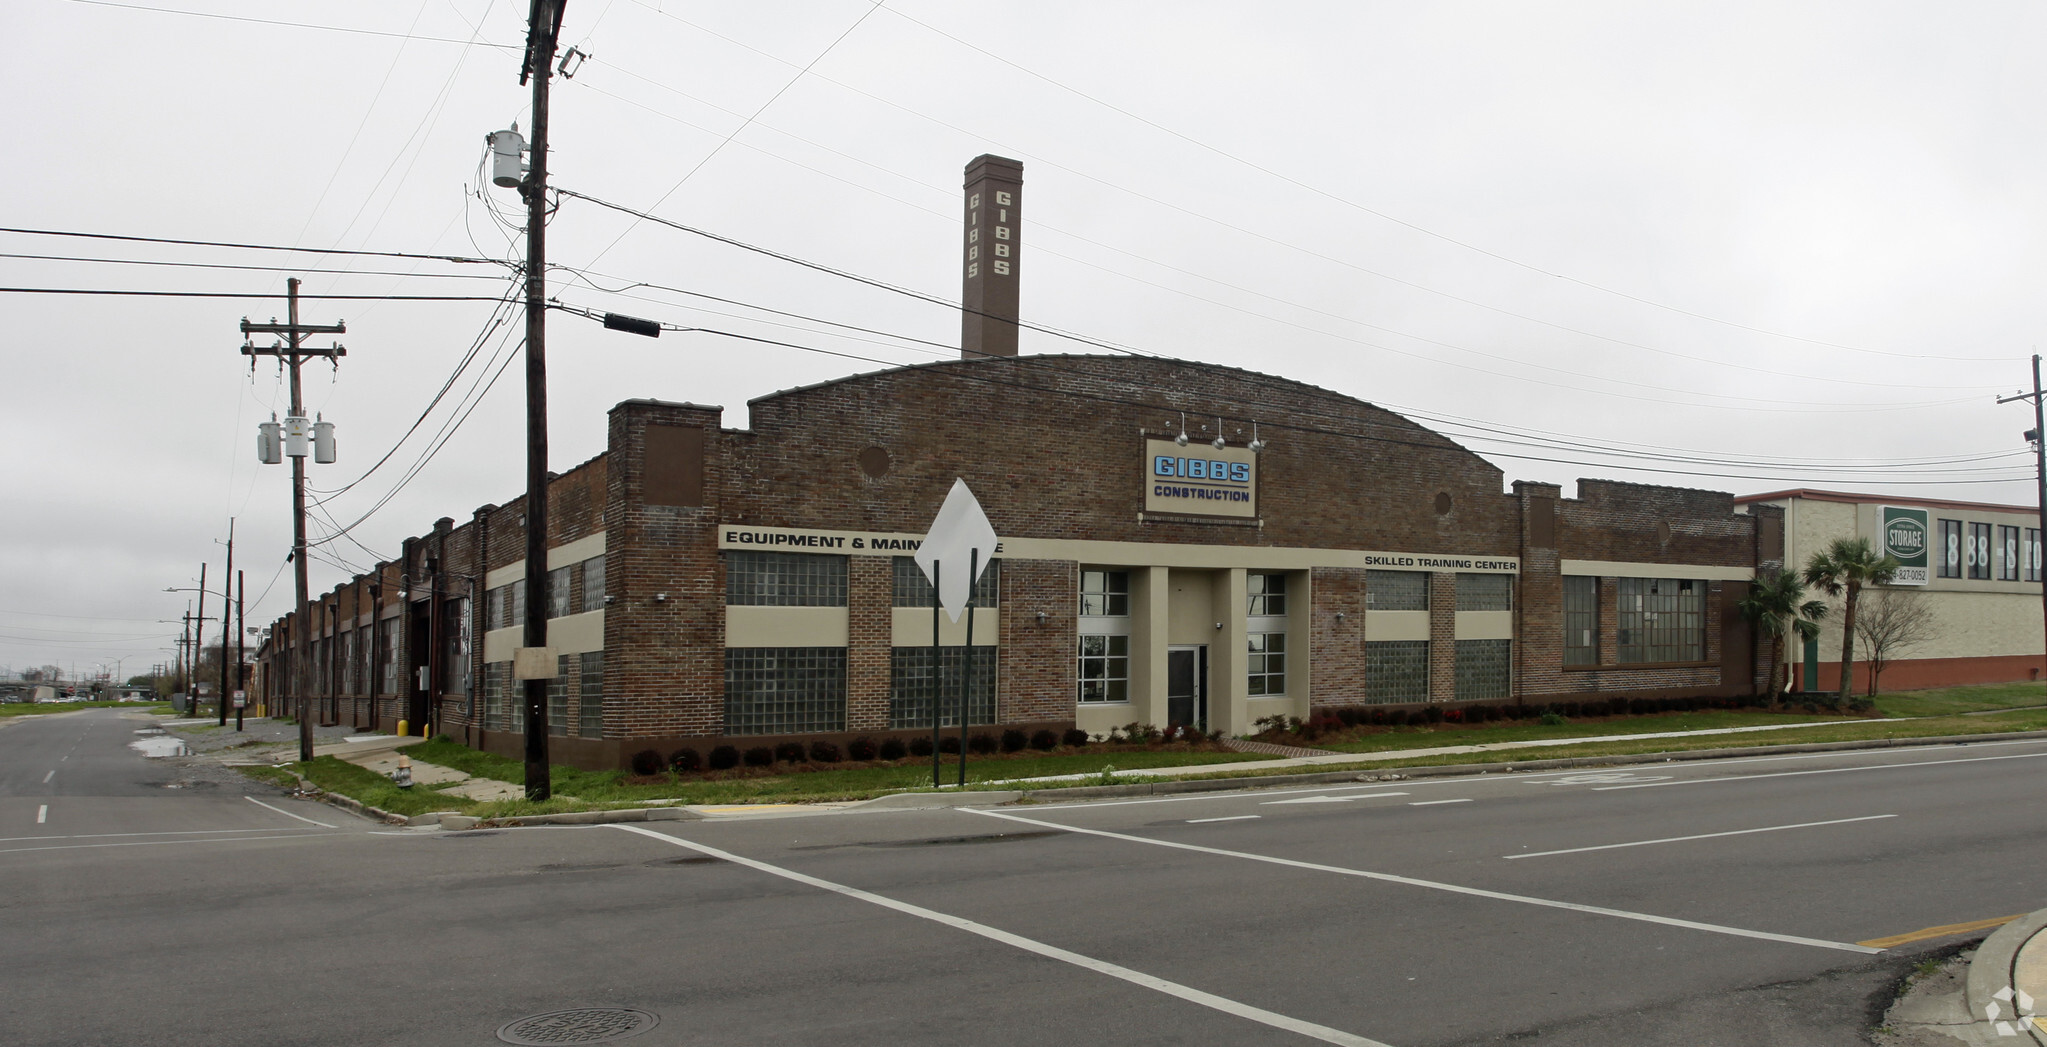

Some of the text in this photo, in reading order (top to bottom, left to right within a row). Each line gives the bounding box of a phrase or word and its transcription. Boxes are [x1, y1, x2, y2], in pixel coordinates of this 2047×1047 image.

[968, 193, 980, 279] GIBBS
[994, 190, 1011, 276] GIBBS
[1154, 455, 1250, 482] GIBBS
[1154, 485, 1250, 502] CONSTRUCTION
[726, 531, 845, 548] EQUIPMENT
[851, 537, 865, 549] &
[1889, 529, 1922, 547] STORAGE
[1364, 556, 1517, 570] SKILLED TRAINING CENTER
